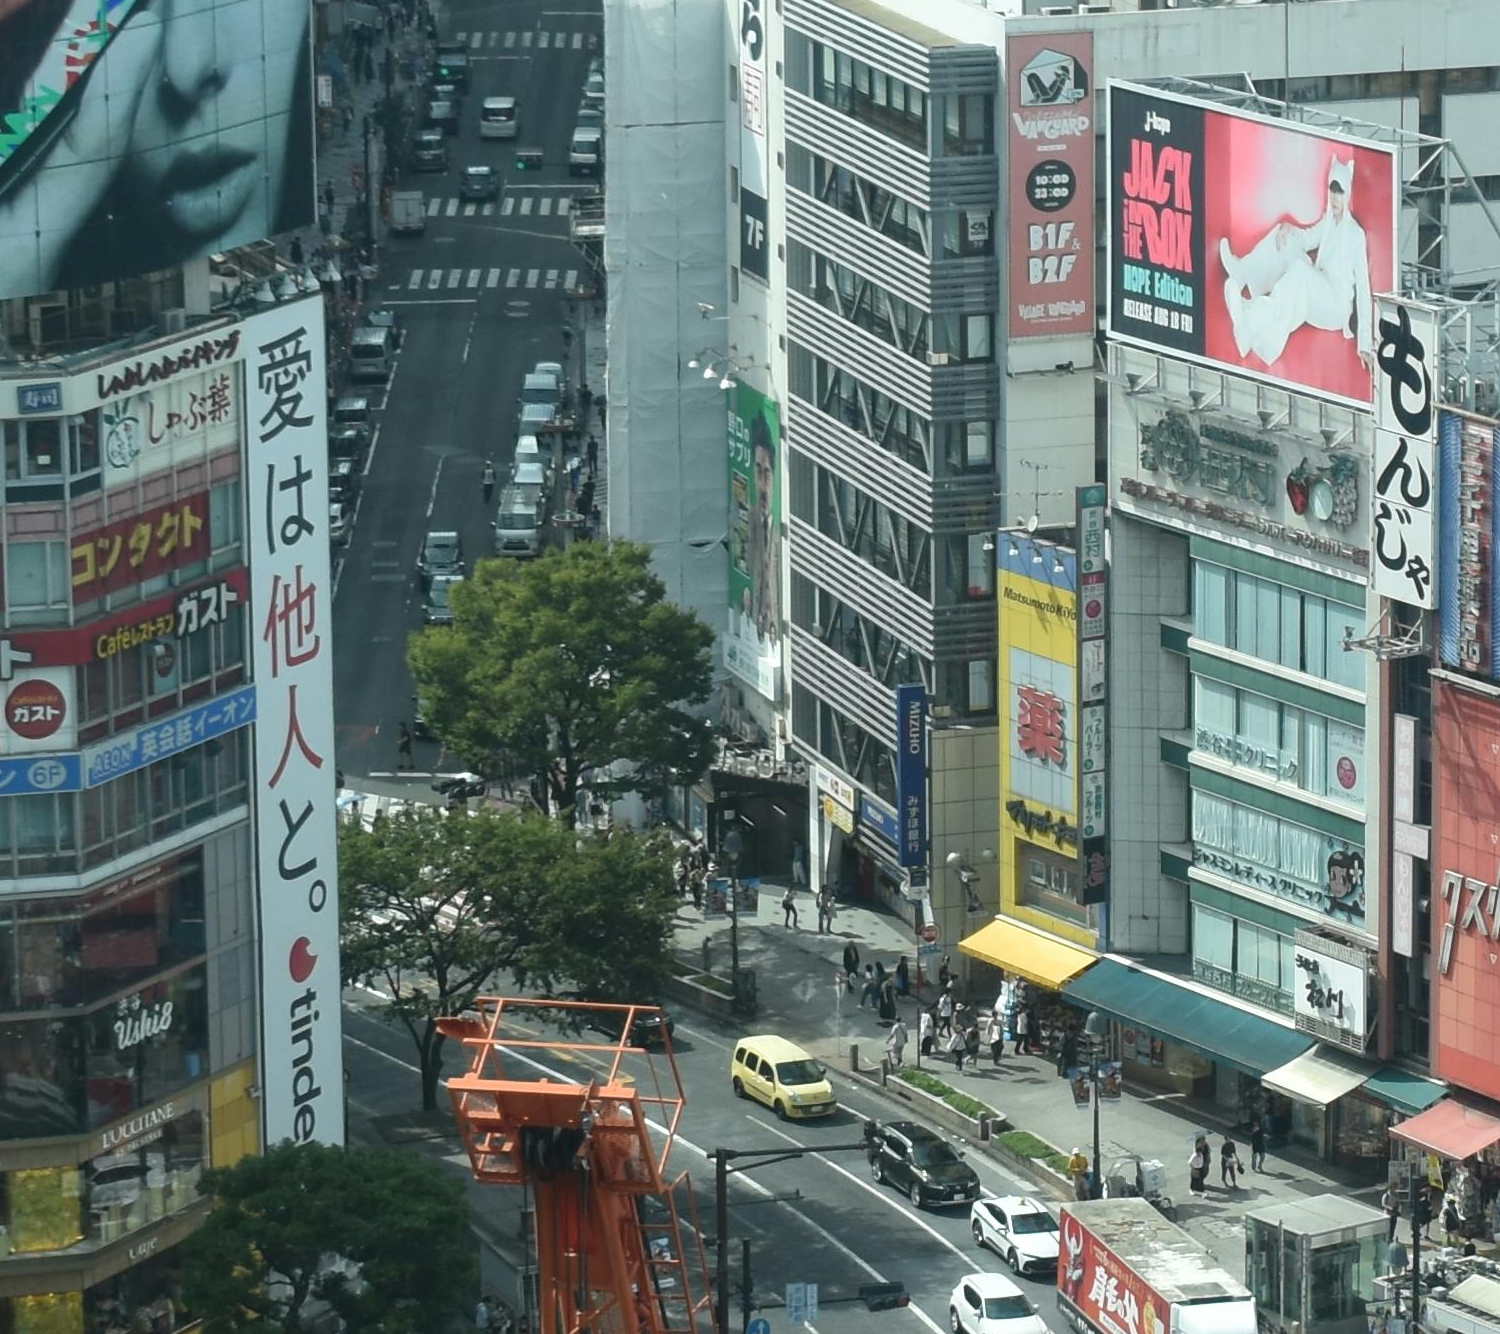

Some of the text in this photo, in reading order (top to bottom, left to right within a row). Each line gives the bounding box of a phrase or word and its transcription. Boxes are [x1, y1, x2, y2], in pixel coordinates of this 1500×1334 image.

[1123, 137, 1194, 213] JACK
[743, 211, 767, 249] 7F
[1029, 222, 1076, 251] B1F
[1141, 203, 1194, 274] BOX
[1028, 255, 1077, 285] B2F
[1122, 263, 1194, 308] HOPE Edition
[147, 373, 233, 445] しゃぶ葉
[1375, 304, 1434, 602] もんじゃ
[71, 502, 205, 589] コンタクト
[175, 581, 239, 639] ガスト
[255, 325, 330, 915] 愛は他人と。
[12, 704, 62, 724] ガスト
[90, 694, 256, 782] AEON 英会話イーオン
[909, 700, 921, 755] MIZUHO
[1016, 683, 1066, 767] 薬
[33, 763, 63, 787] 6F
[113, 1000, 174, 1049] Ushi8
[100, 1101, 175, 1149] L'OCCITANE
